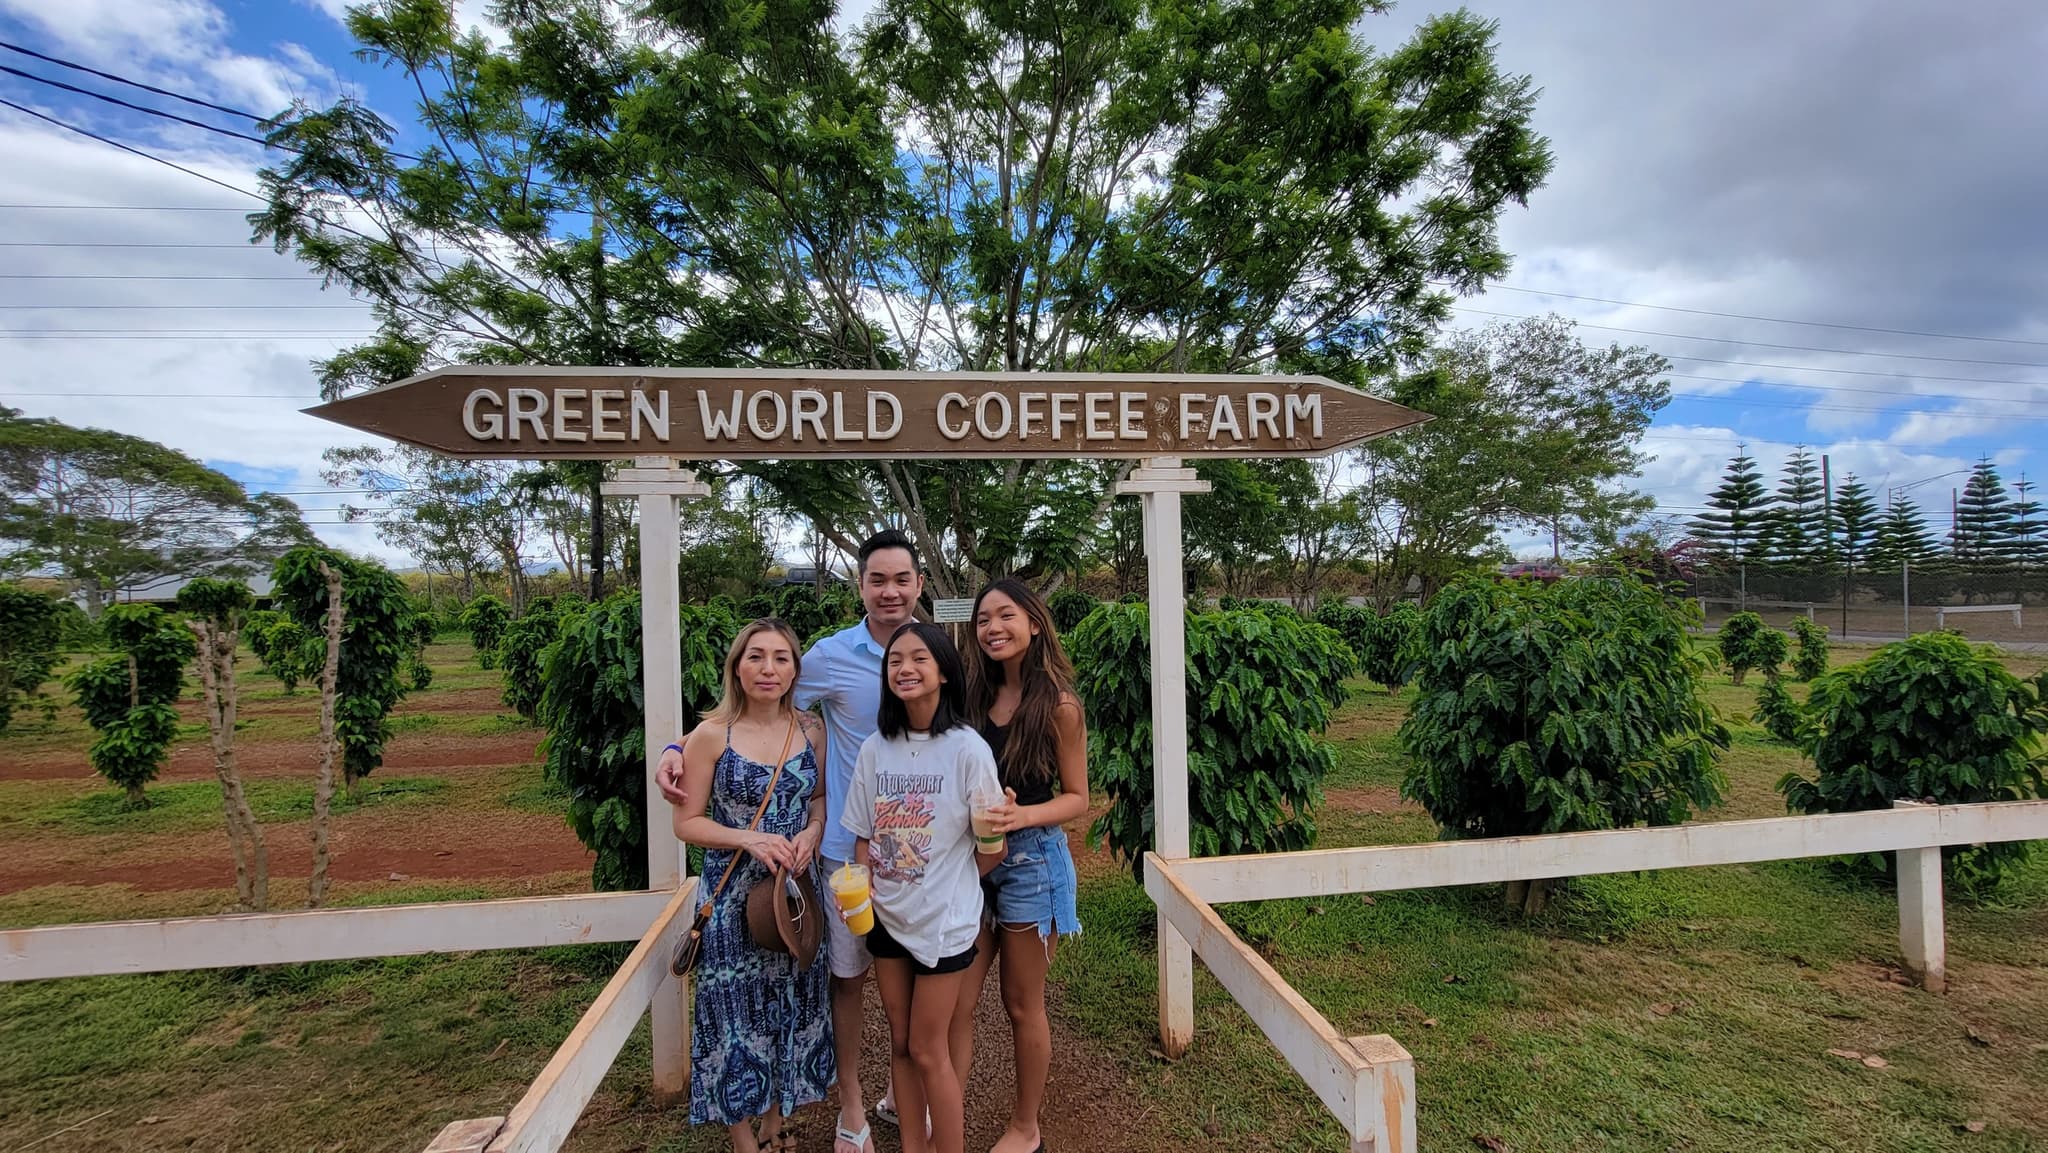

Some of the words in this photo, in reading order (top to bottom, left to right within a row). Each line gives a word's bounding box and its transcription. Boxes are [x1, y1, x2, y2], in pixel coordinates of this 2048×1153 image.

[462, 388, 670, 442] GREEN
[697, 389, 903, 441] WORLD
[936, 391, 1148, 441] COFFEE
[1179, 392, 1323, 441] FARM
